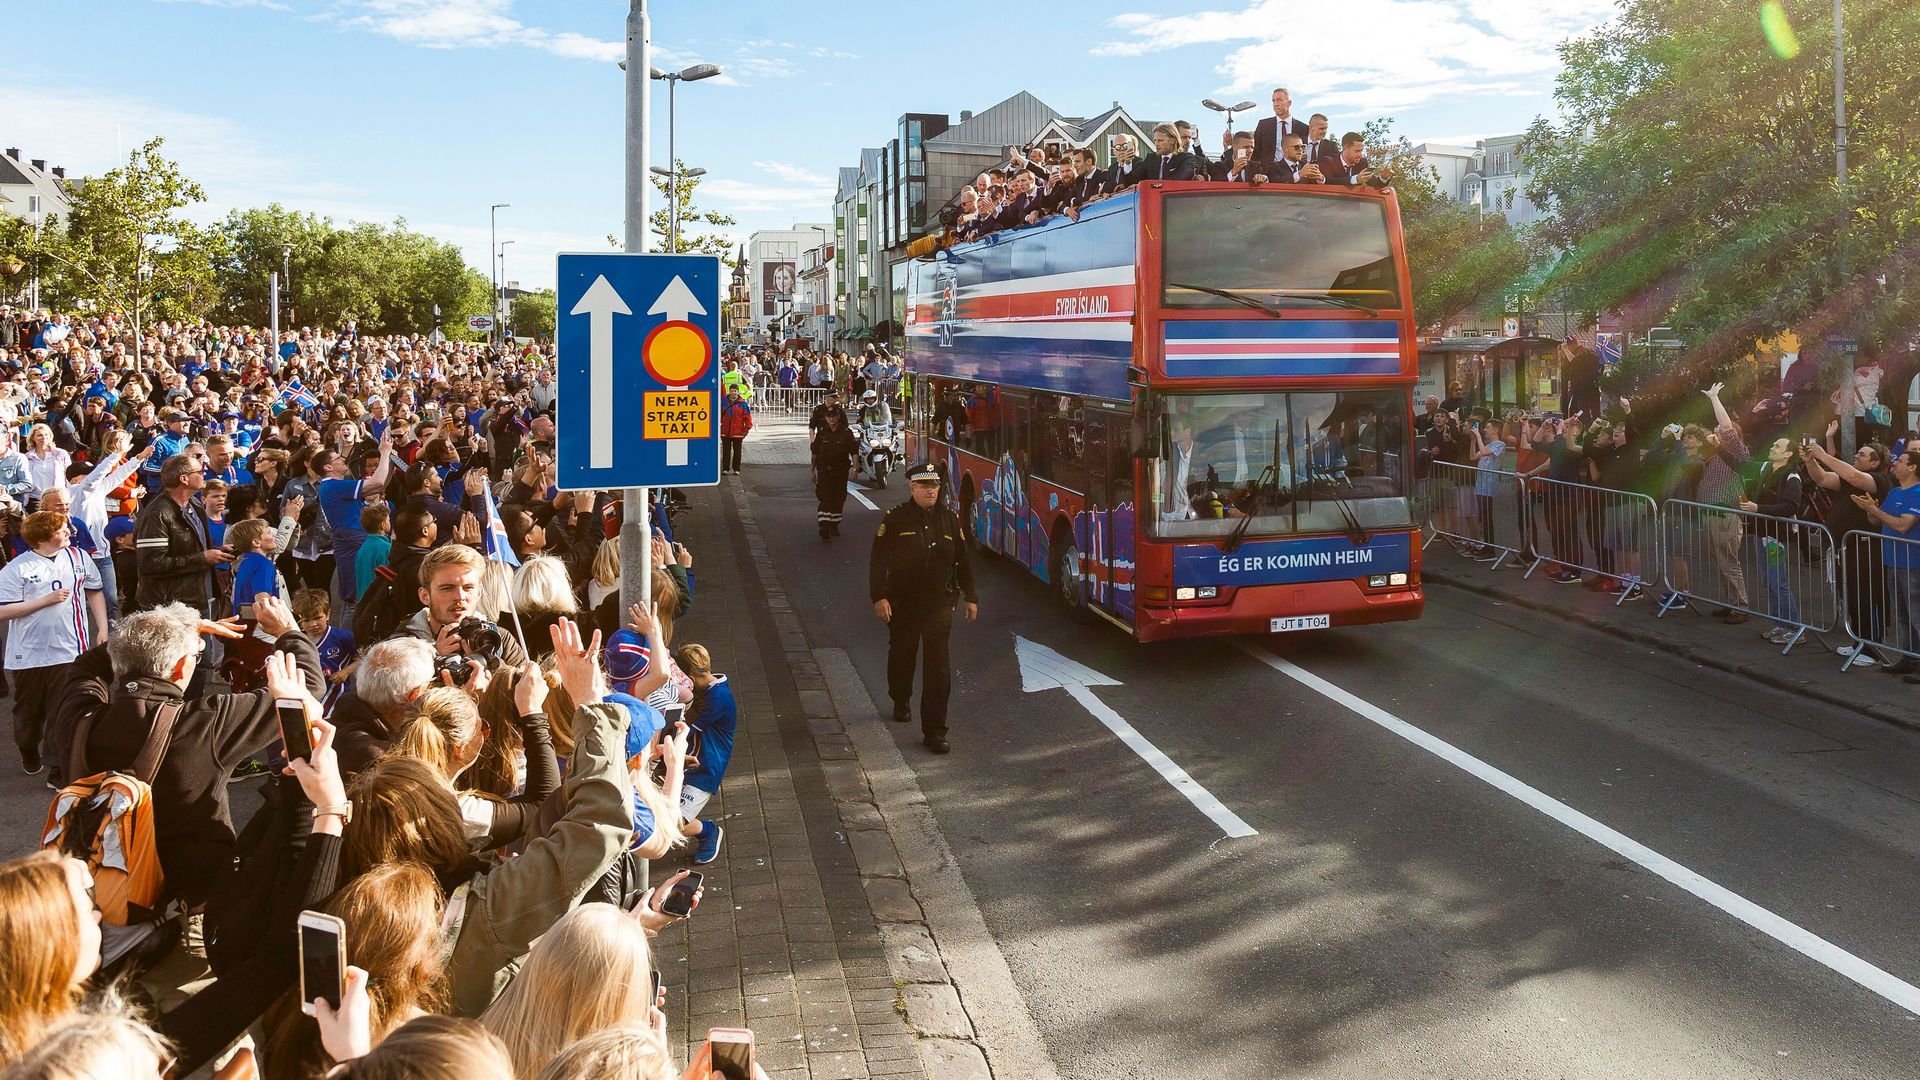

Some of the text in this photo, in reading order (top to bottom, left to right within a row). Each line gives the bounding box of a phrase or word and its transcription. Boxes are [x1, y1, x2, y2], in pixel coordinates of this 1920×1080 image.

[1078, 291, 1109, 314] ÍSLAND
[656, 396, 699, 407] NEMA
[647, 408, 707, 422] STRÆTÓ
[660, 423, 694, 433] TAXI
[1219, 549, 1373, 573] ÉG ER KOMINN HEIM
[1281, 619, 1296, 630] JT
[1305, 617, 1327, 627] T04
